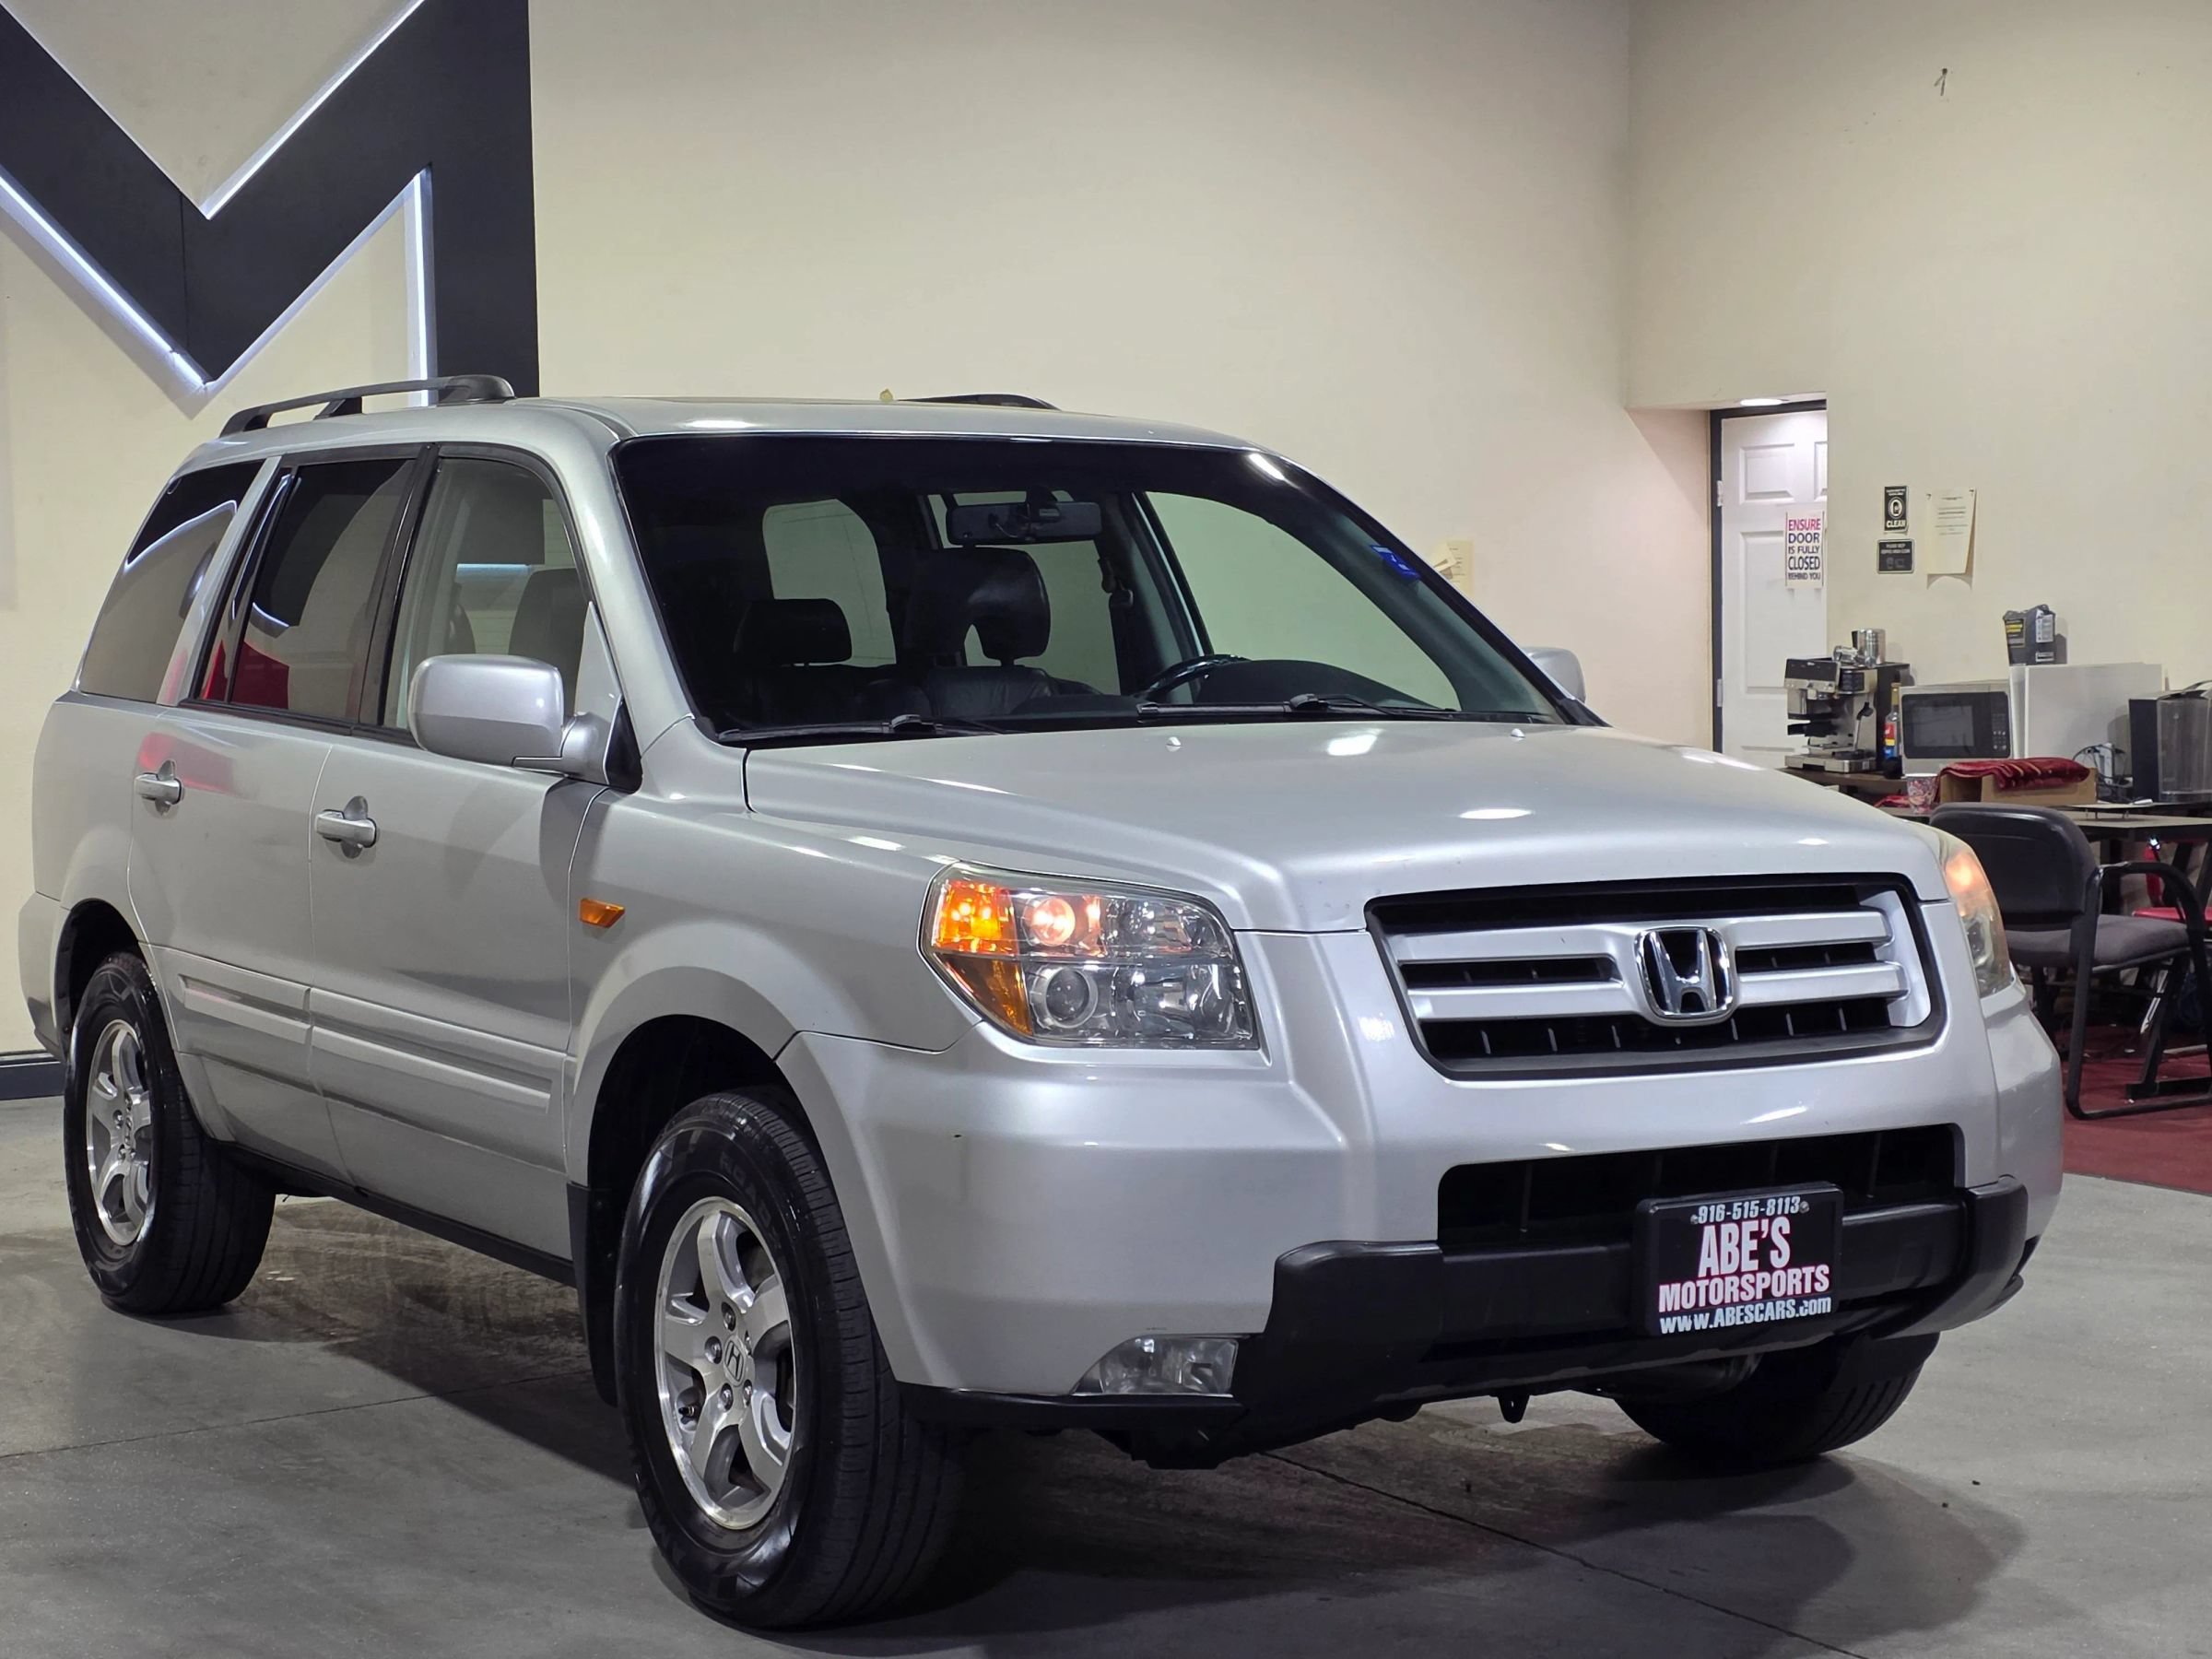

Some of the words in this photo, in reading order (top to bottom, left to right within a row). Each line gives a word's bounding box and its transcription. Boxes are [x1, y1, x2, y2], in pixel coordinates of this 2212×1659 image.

[1788, 518, 1821, 531] ENSURE
[1788, 532, 1820, 544] DOOR
[1788, 545, 1795, 554] IS
[1797, 545, 1820, 554] FULLY
[1788, 556, 1820, 571] CLOSED
[1808, 571, 1821, 580] YOU
[1698, 1196, 1800, 1224] 916-515-8113
[1698, 1217, 1791, 1277] ABE'S
[1659, 1265, 1830, 1312] MOTORSPORTS
